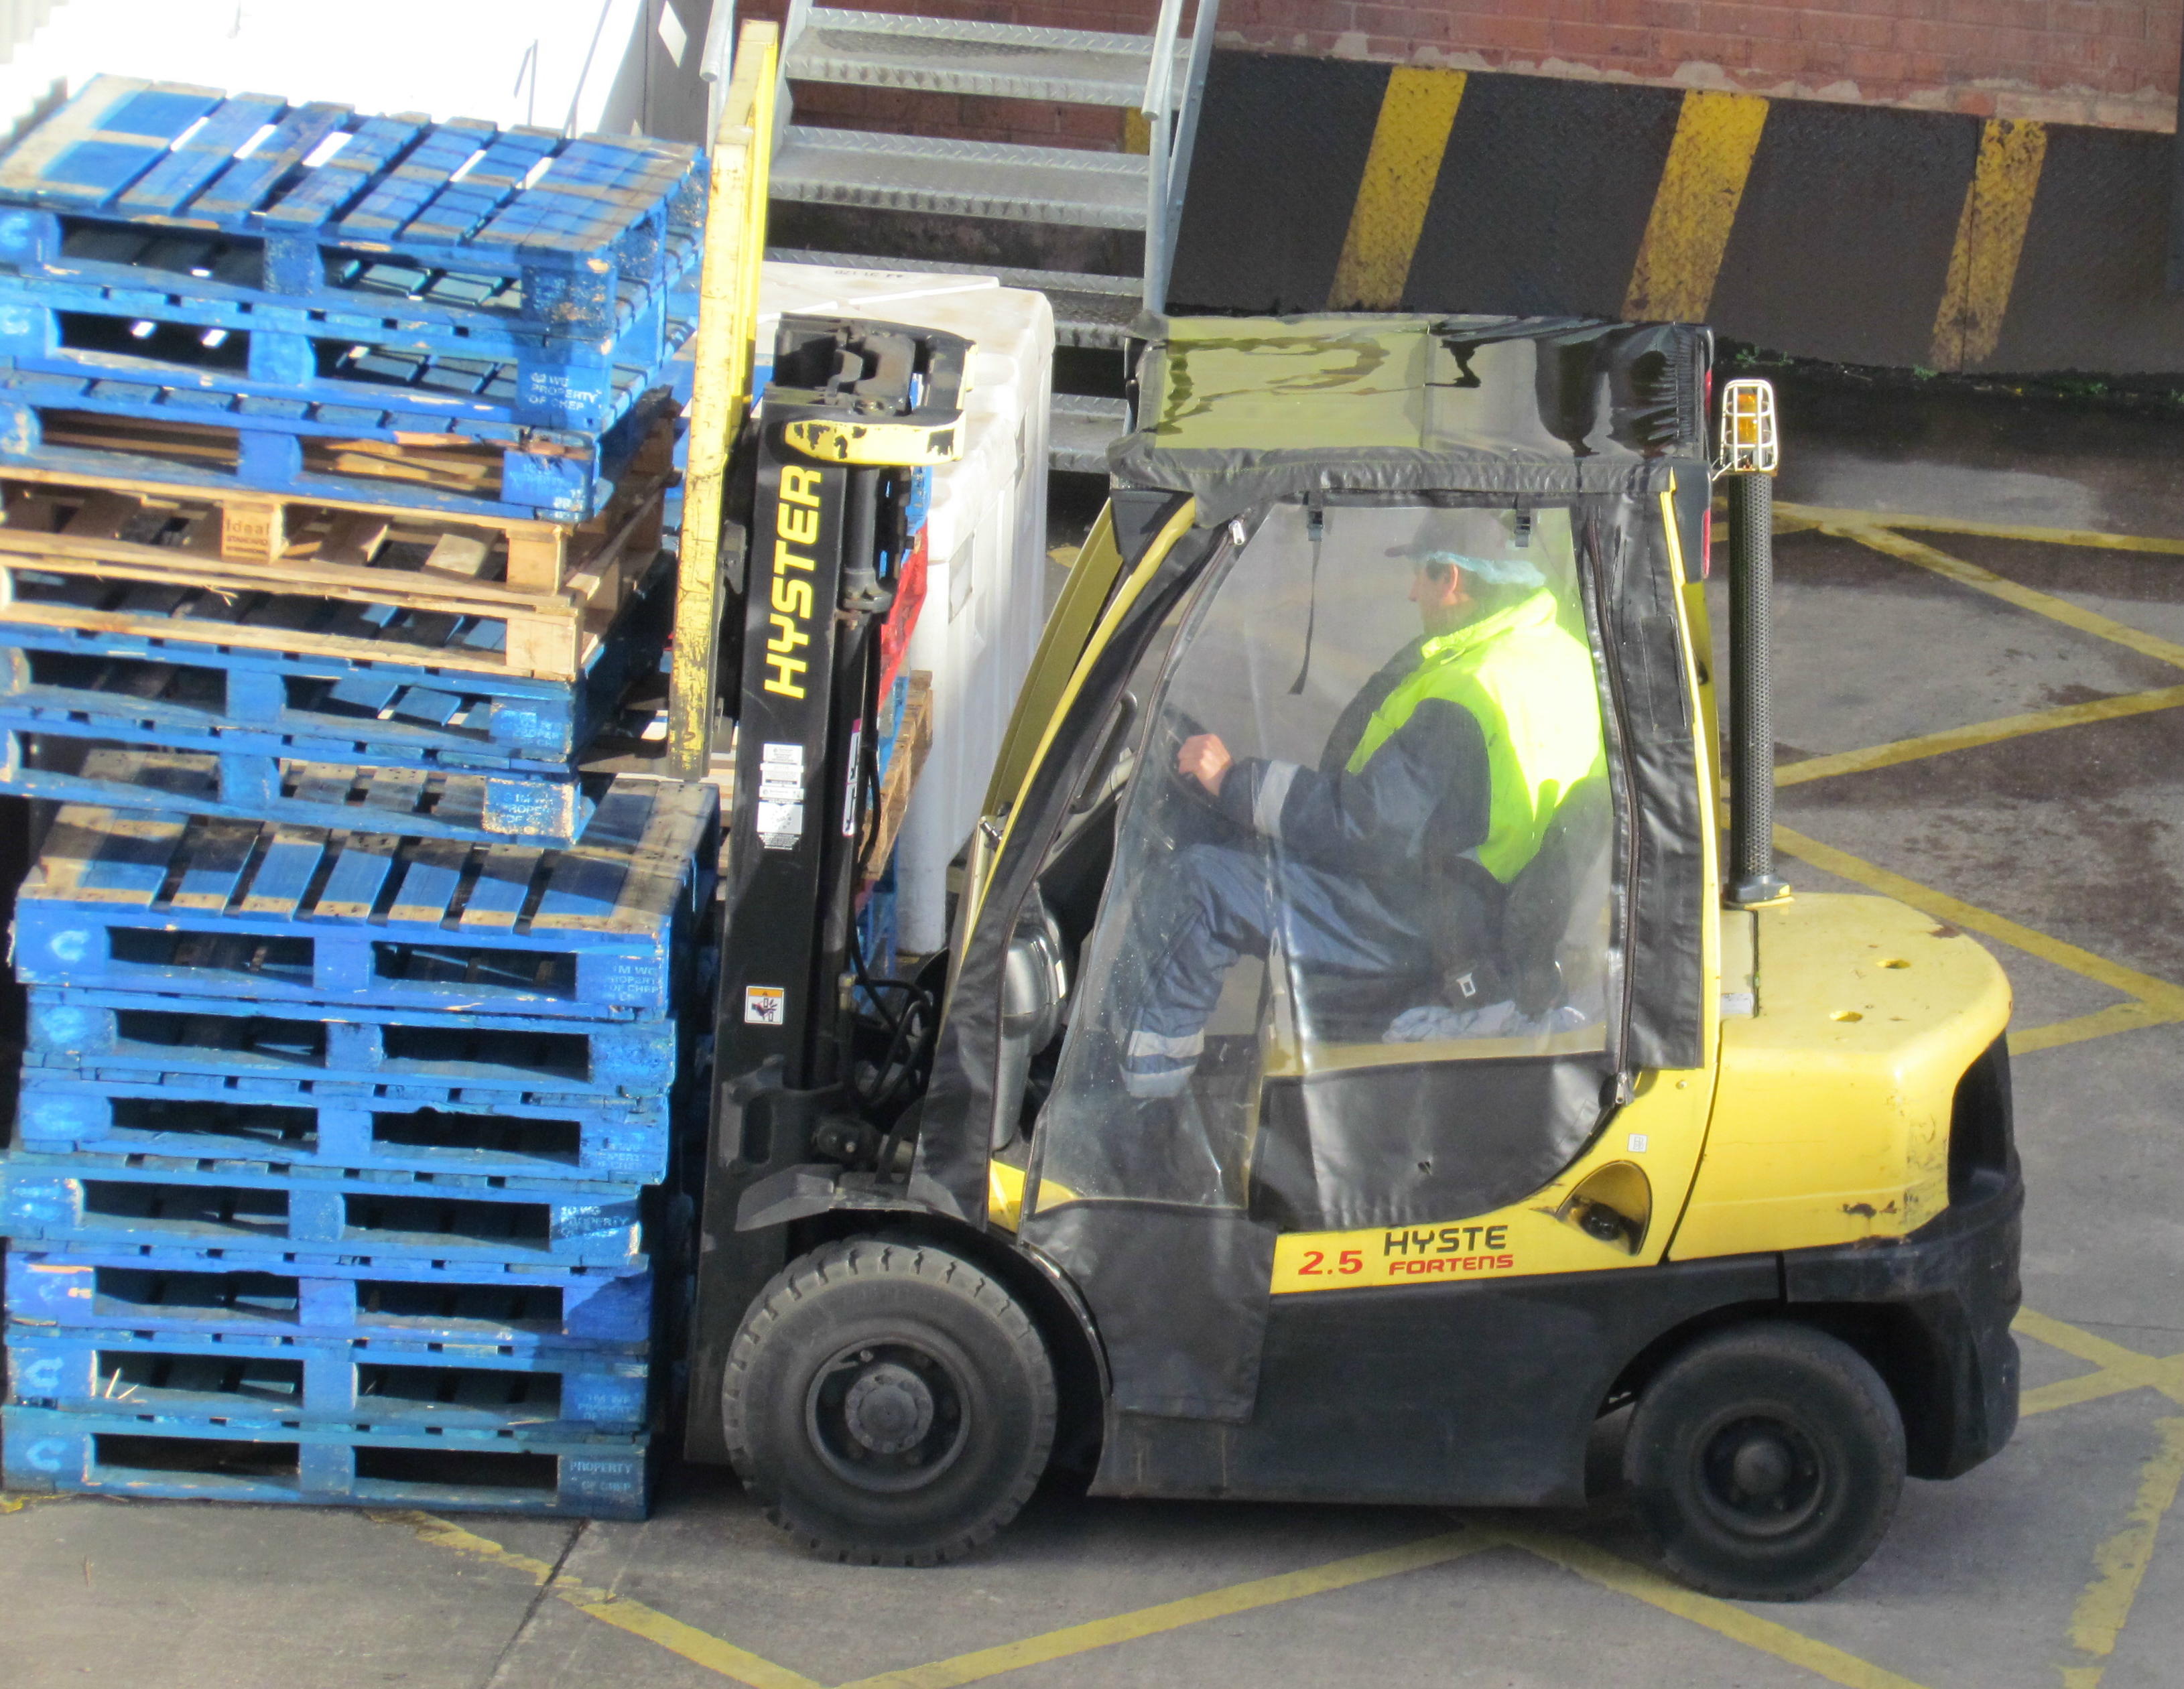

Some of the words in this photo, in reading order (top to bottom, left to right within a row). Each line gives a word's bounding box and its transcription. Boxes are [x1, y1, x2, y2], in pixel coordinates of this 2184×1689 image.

[530, 383, 599, 403] PROPERTY
[552, 398, 585, 411] CHEP
[226, 517, 269, 536] Ideal
[764, 465, 822, 699] HYSTER
[1384, 1225, 1508, 1256] HYSTE
[1297, 1250, 1363, 1275] 2.5
[1389, 1254, 1514, 1276] FORTENS
[570, 1461, 633, 1474] PROPERTY
